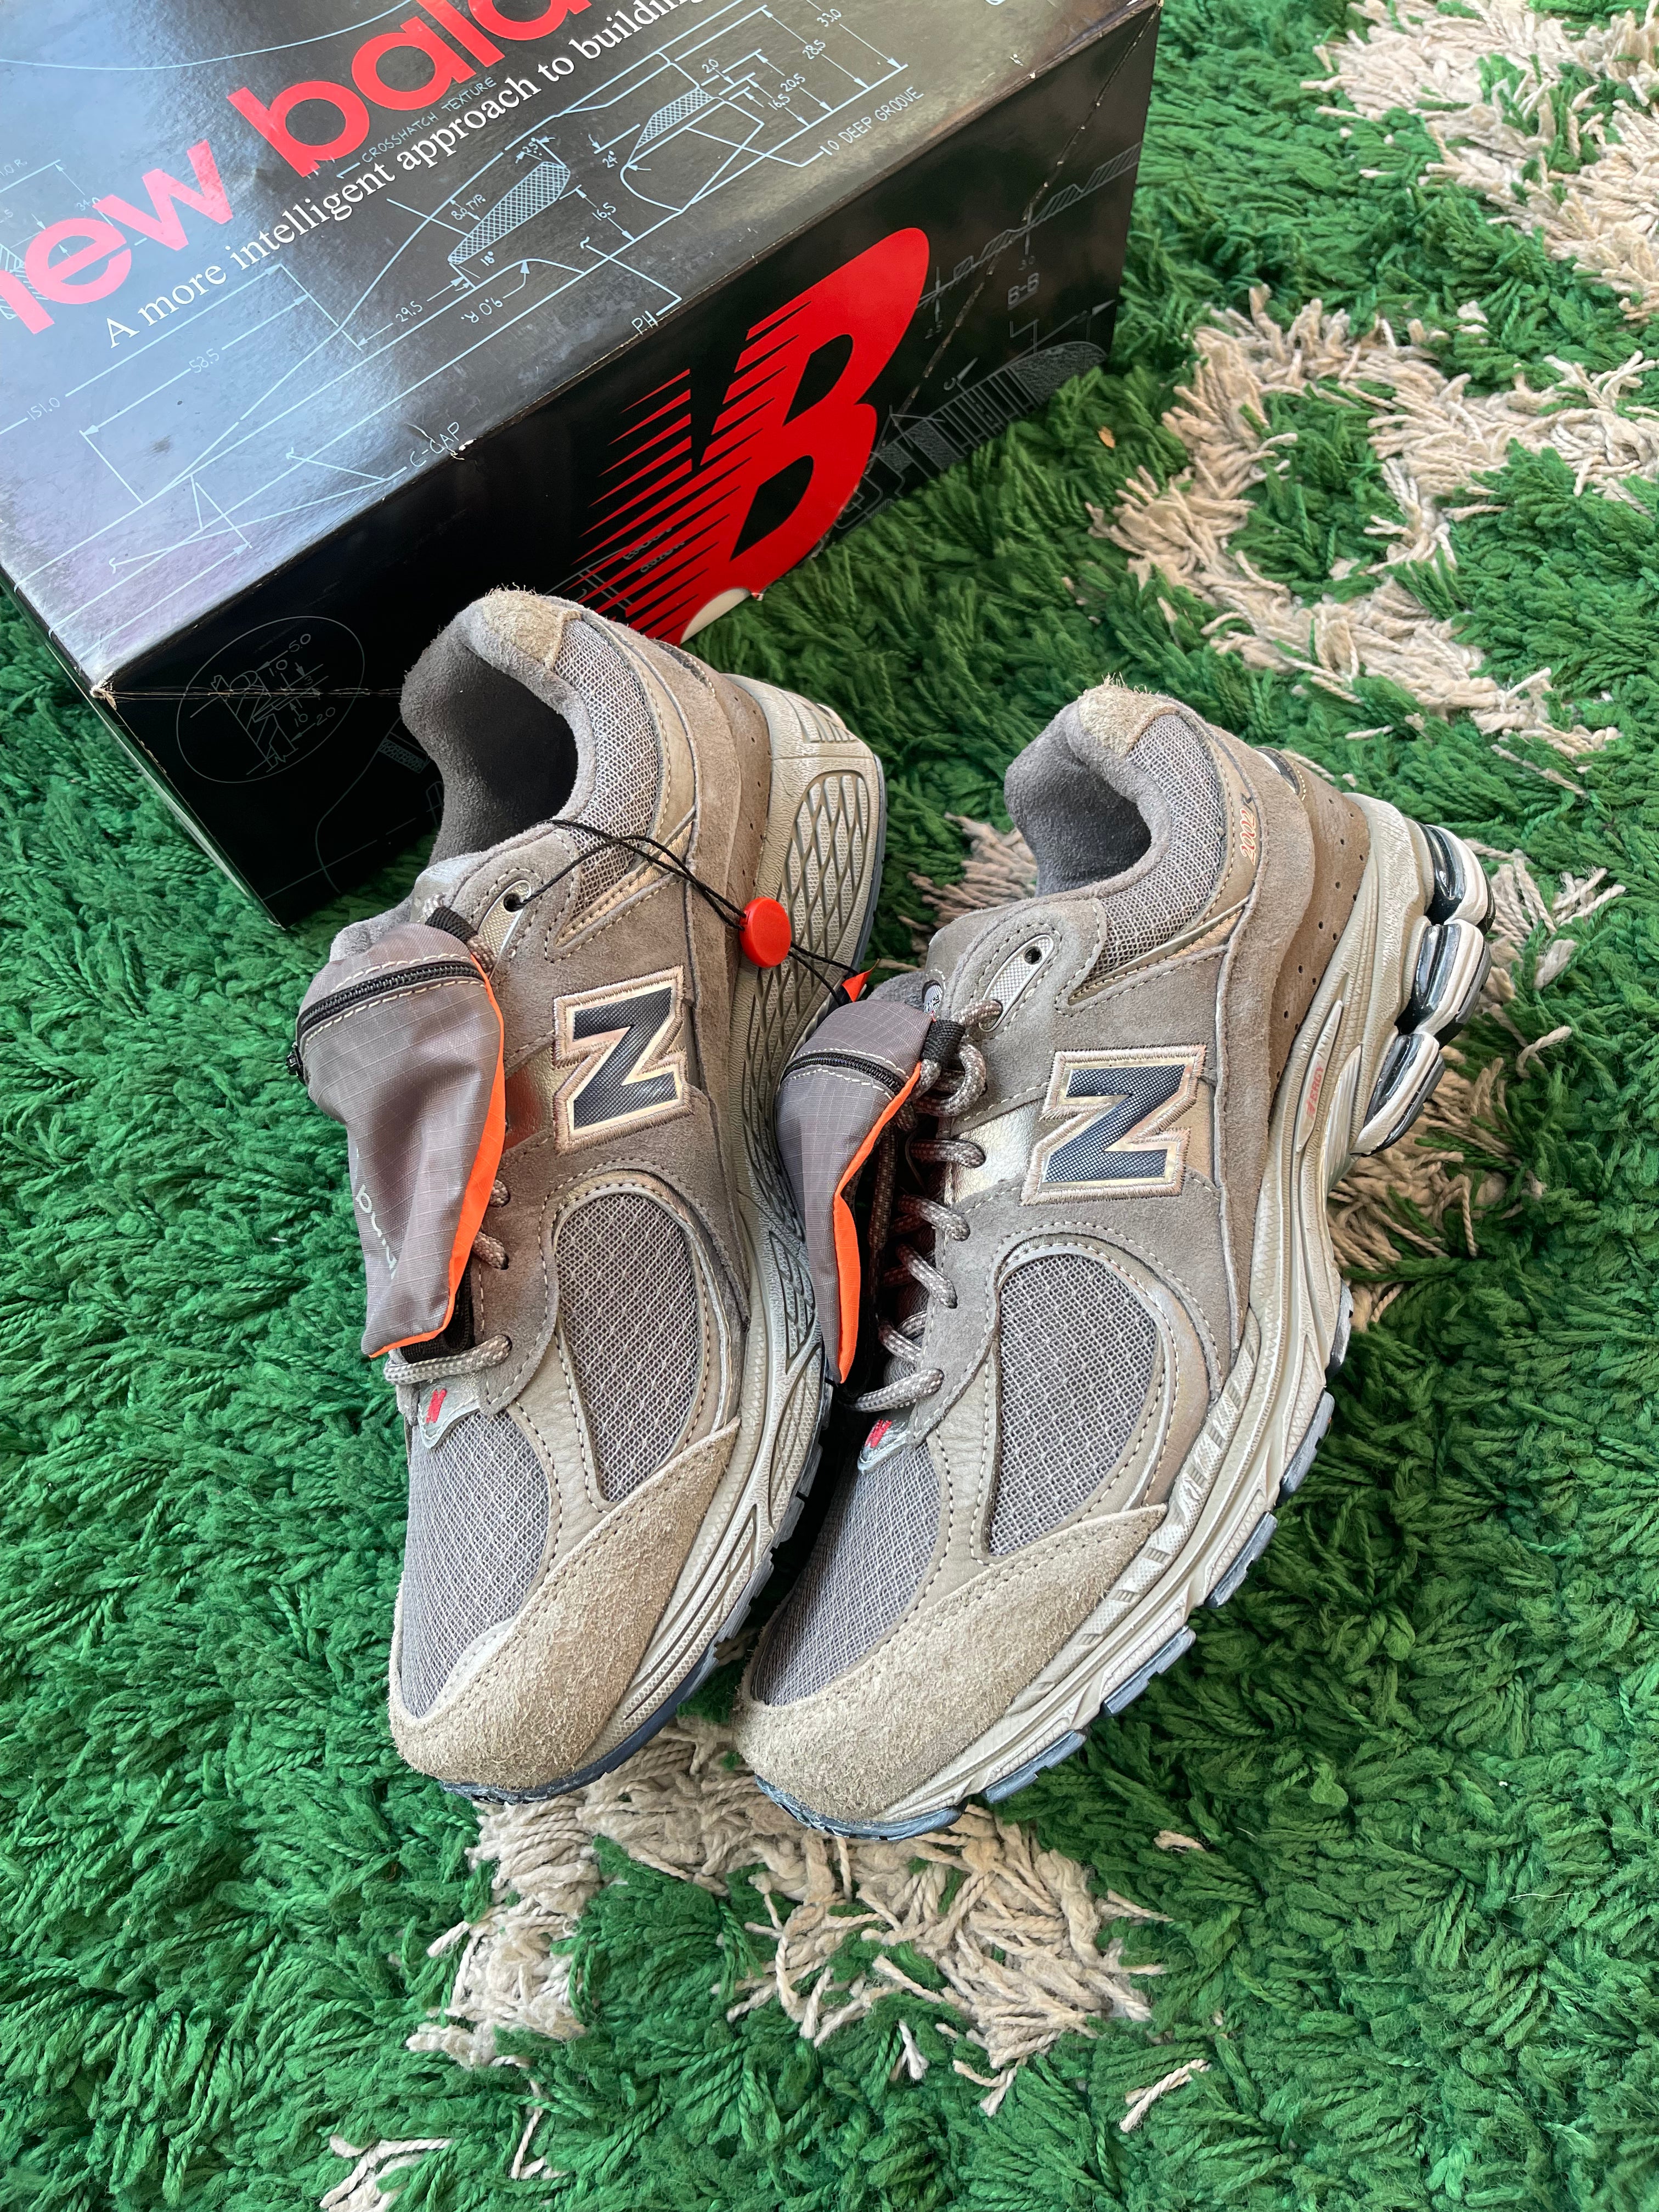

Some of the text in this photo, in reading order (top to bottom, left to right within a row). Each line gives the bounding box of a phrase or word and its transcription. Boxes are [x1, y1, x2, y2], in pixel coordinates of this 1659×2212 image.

[362, 77, 497, 163] CROSSHATCH TEXTURE
[838, 116, 872, 144] DEEP
[874, 86, 925, 121] GROOVE
[106, 317, 139, 348] A
[138, 266, 227, 326] more
[225, 162, 395, 271] intelligent
[396, 77, 543, 171] approach
[537, 57, 575, 82] to
[396, 300, 423, 323] 29.5
[631, 310, 658, 336] PH
[188, 348, 219, 373] 58.5
[552, 966, 692, 1154] N
[1022, 1044, 1206, 1205] N
